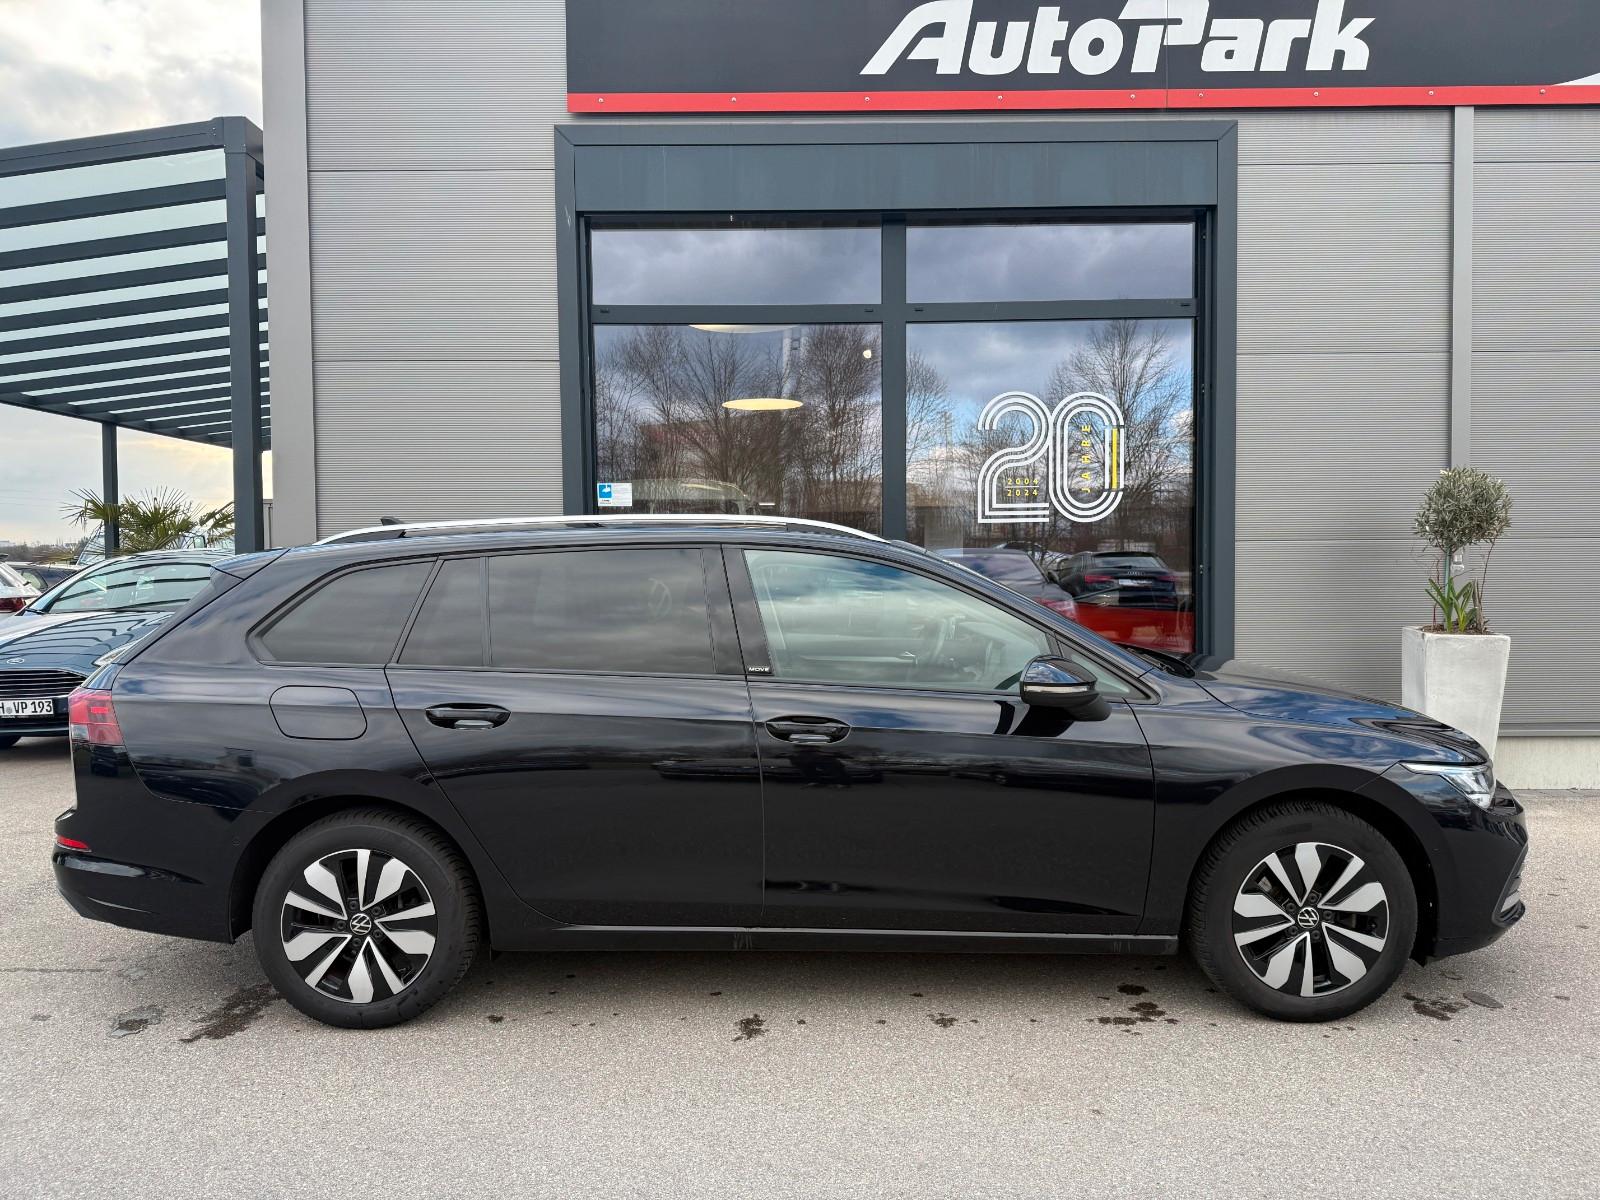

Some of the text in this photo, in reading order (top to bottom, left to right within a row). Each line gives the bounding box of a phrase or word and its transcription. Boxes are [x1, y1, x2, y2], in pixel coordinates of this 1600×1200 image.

[860, 0, 1376, 75] AutoPark
[978, 391, 1124, 523] 20
[1081, 424, 1091, 493] JAHRE
[1007, 489, 1039, 497] 2024
[13, 702, 28, 713] VP
[30, 701, 53, 713] 193
